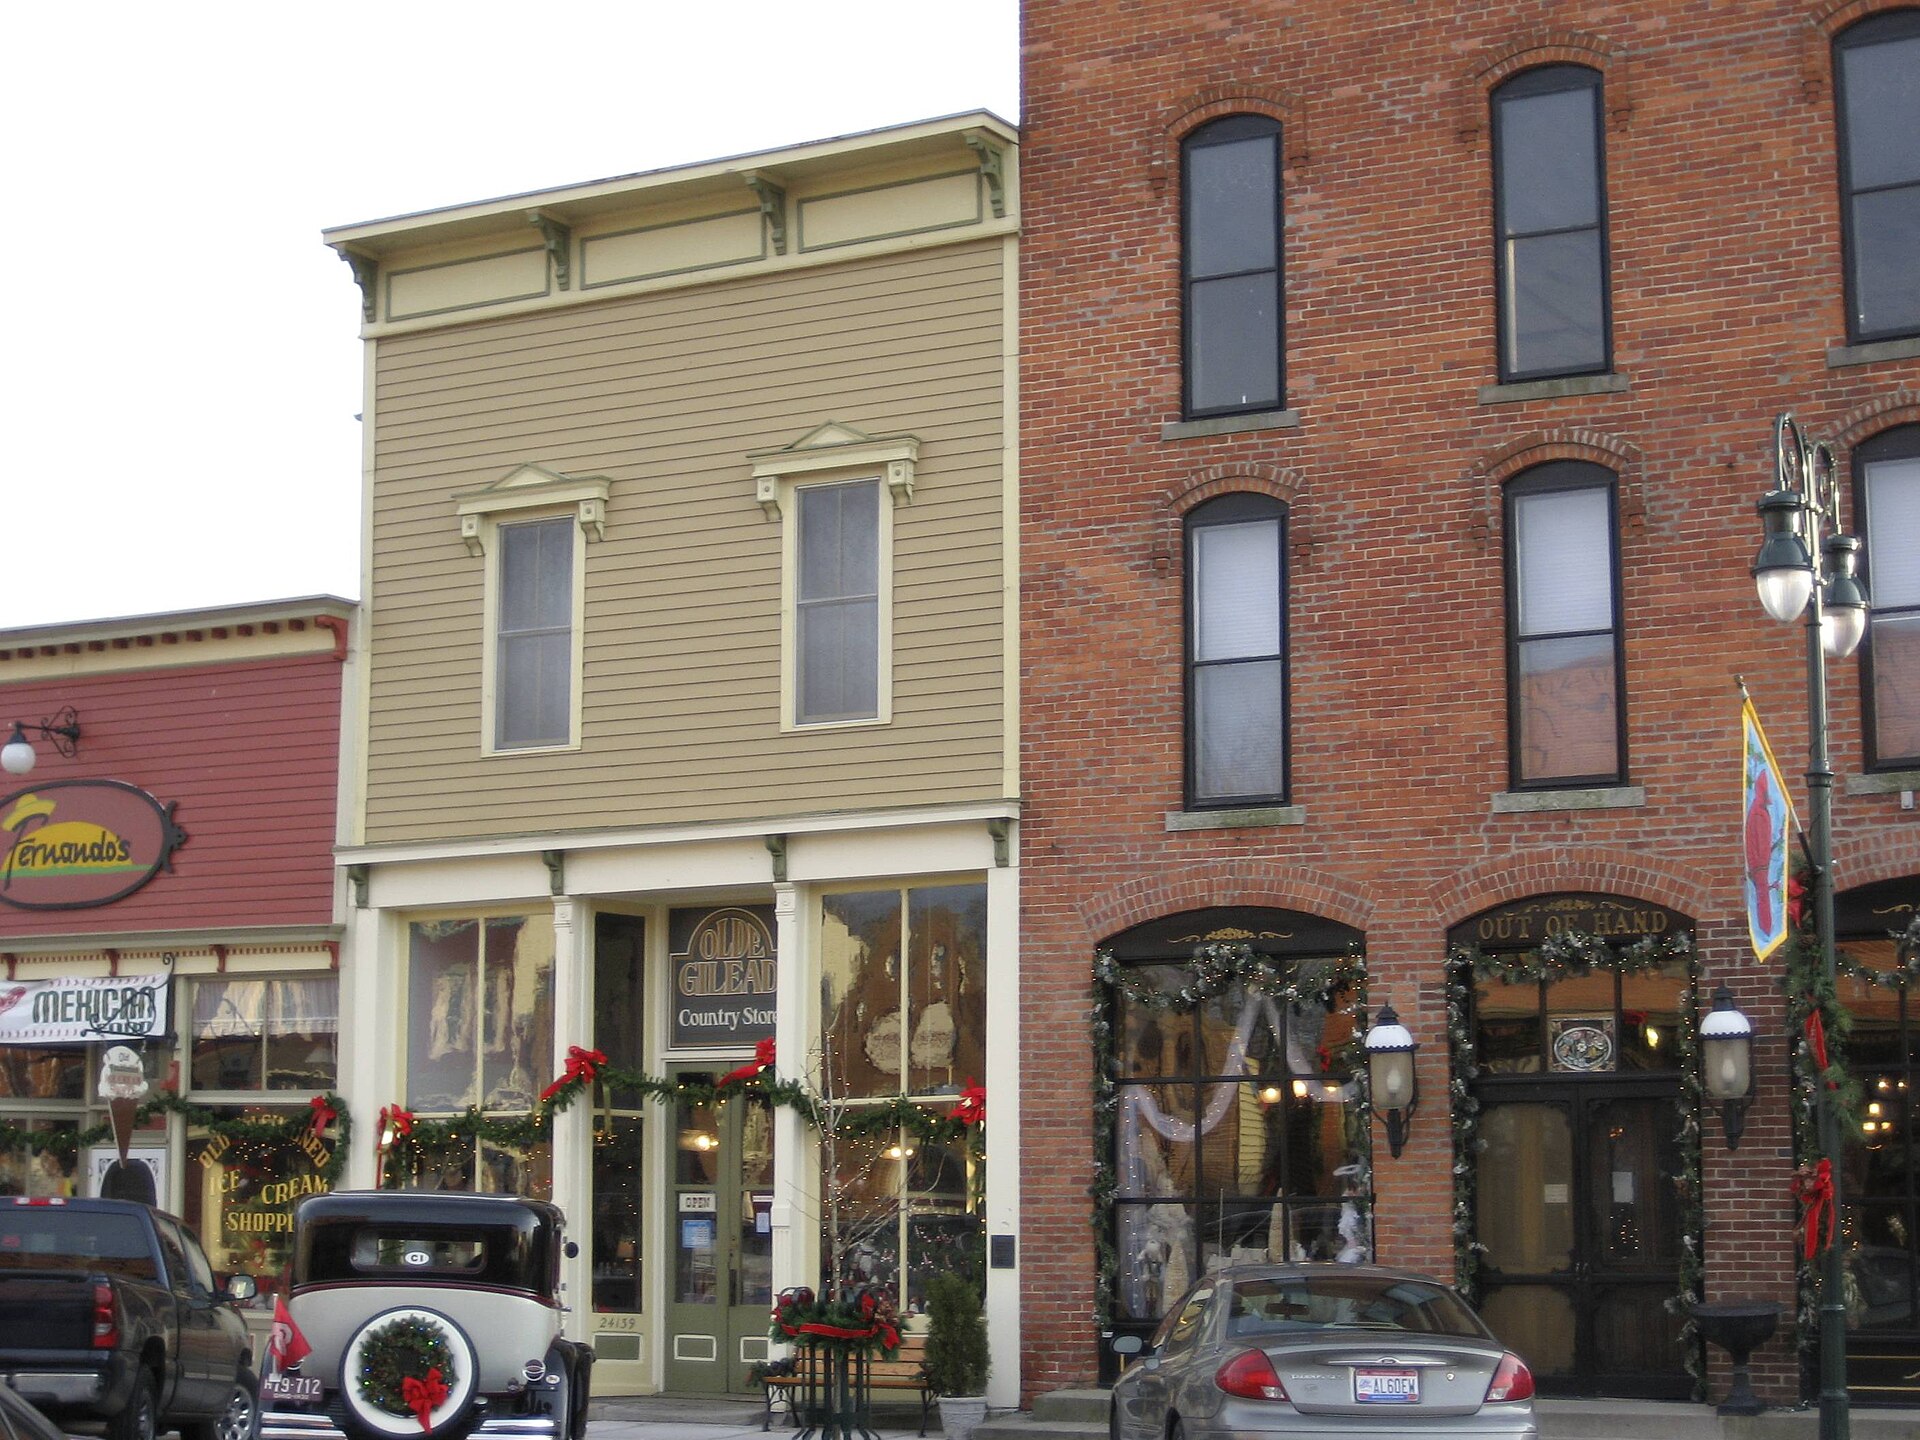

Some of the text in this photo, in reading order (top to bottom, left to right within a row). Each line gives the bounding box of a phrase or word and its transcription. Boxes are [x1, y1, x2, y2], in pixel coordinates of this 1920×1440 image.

[3, 812, 131, 892] Fernando's
[700, 918, 766, 960] OLDE
[1478, 911, 1668, 939] OUT OF HAND
[679, 959, 777, 996] GILEAD
[32, 986, 156, 1024] MEXICAN
[679, 1007, 778, 1031] Country Store
[198, 1134, 231, 1169] OLD
[208, 1169, 329, 1205] ICE CREAM
[685, 1196, 711, 1208] OPEN
[599, 1317, 636, 1330] 24139
